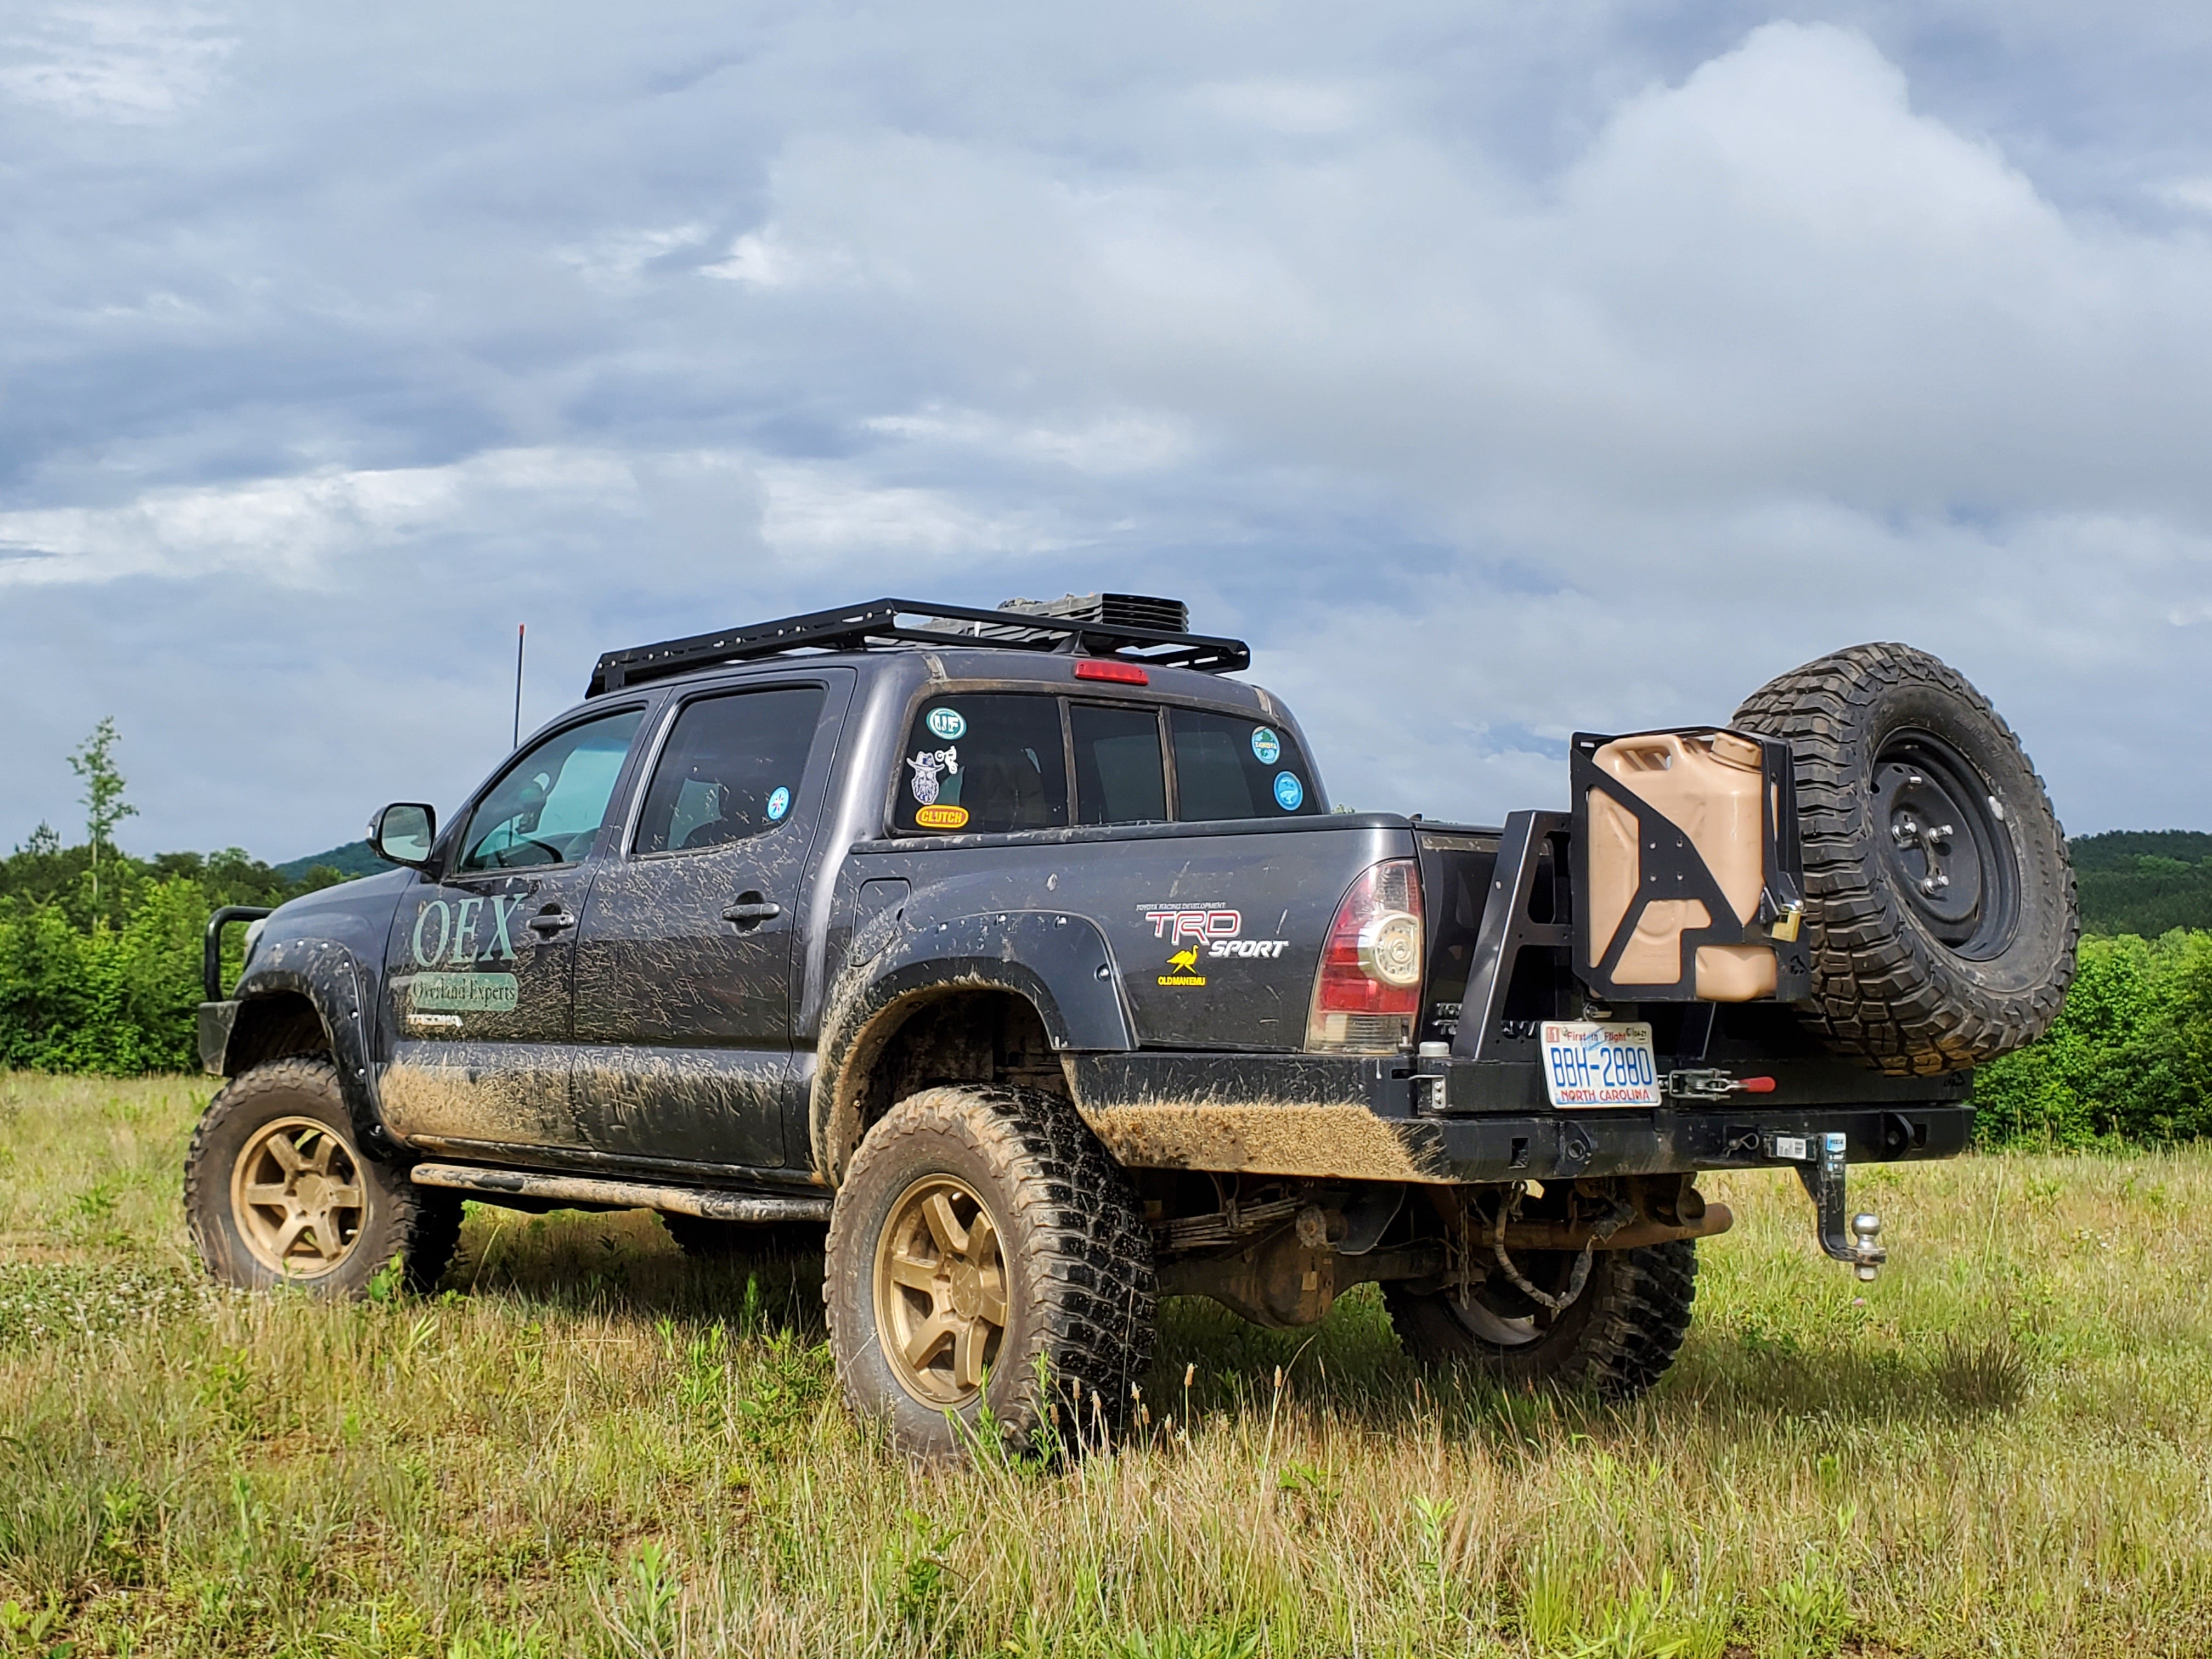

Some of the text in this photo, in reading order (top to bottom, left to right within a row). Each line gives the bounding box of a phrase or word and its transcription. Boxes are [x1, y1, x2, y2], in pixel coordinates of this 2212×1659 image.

[921, 810, 962, 823] CLUTCH
[413, 893, 528, 967] OEX
[1146, 909, 1242, 946] TRD
[1208, 940, 1290, 958] SPORT
[413, 977, 516, 1007] Overland Experts
[1566, 1031, 1587, 1041] First
[1604, 1031, 1627, 1043] Flight
[1550, 1047, 1652, 1087] BBH-2880
[1561, 1088, 1650, 1102] NORTH CAROLINA
